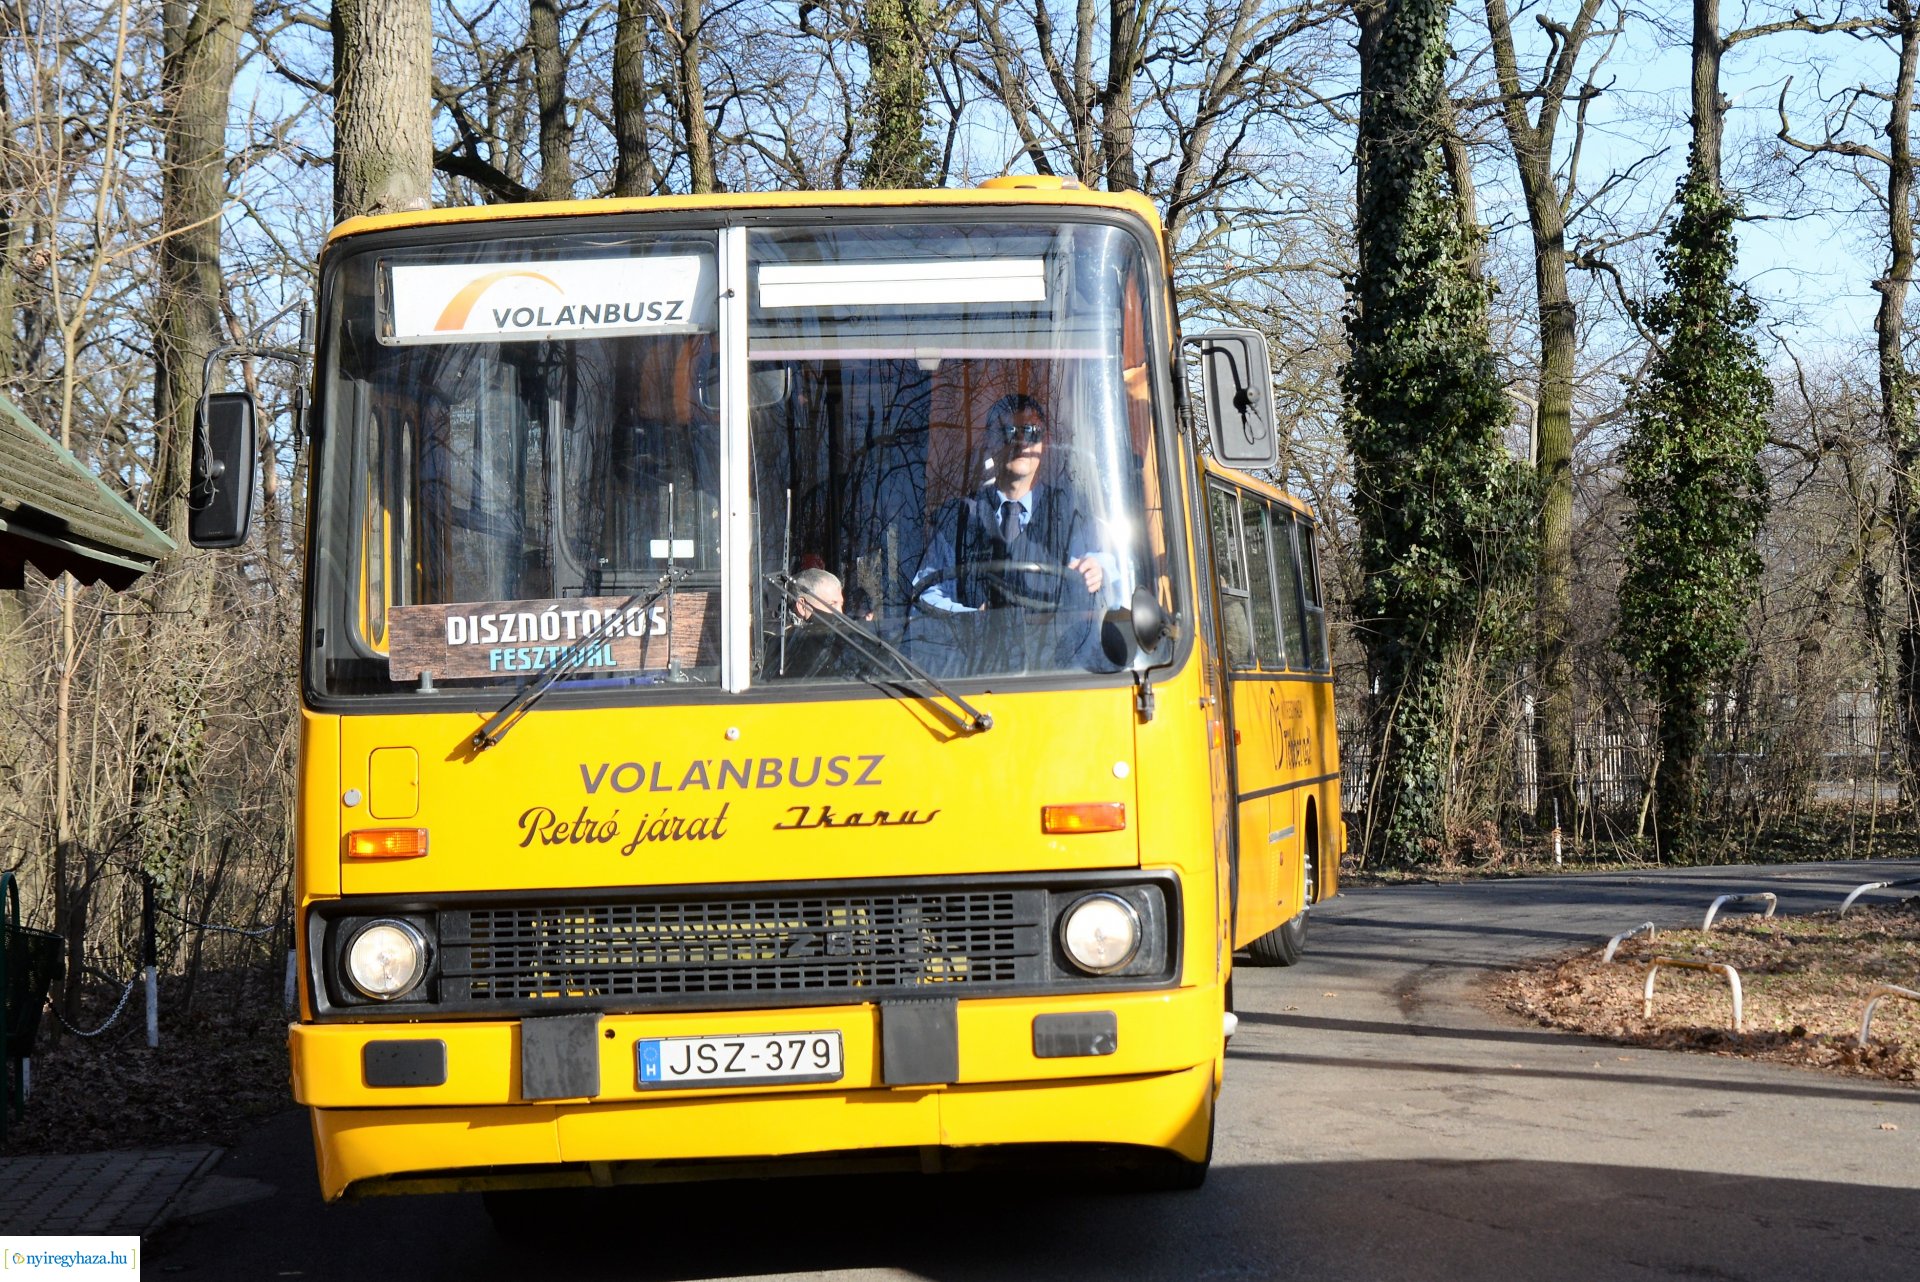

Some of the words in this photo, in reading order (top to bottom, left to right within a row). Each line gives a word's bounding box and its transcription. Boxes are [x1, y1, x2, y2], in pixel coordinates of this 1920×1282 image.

[492, 300, 685, 328] VOLÁNBUSZ
[446, 605, 668, 645] DISZNÓTOROS
[489, 639, 618, 671] FESZTIVÁL
[579, 754, 886, 794] VOLÁNBUSZ
[518, 806, 621, 848] Retró
[620, 802, 730, 857] járat
[773, 806, 943, 831] Ikarus
[646, 1063, 657, 1077] H
[669, 1038, 831, 1075] JSZ-379
